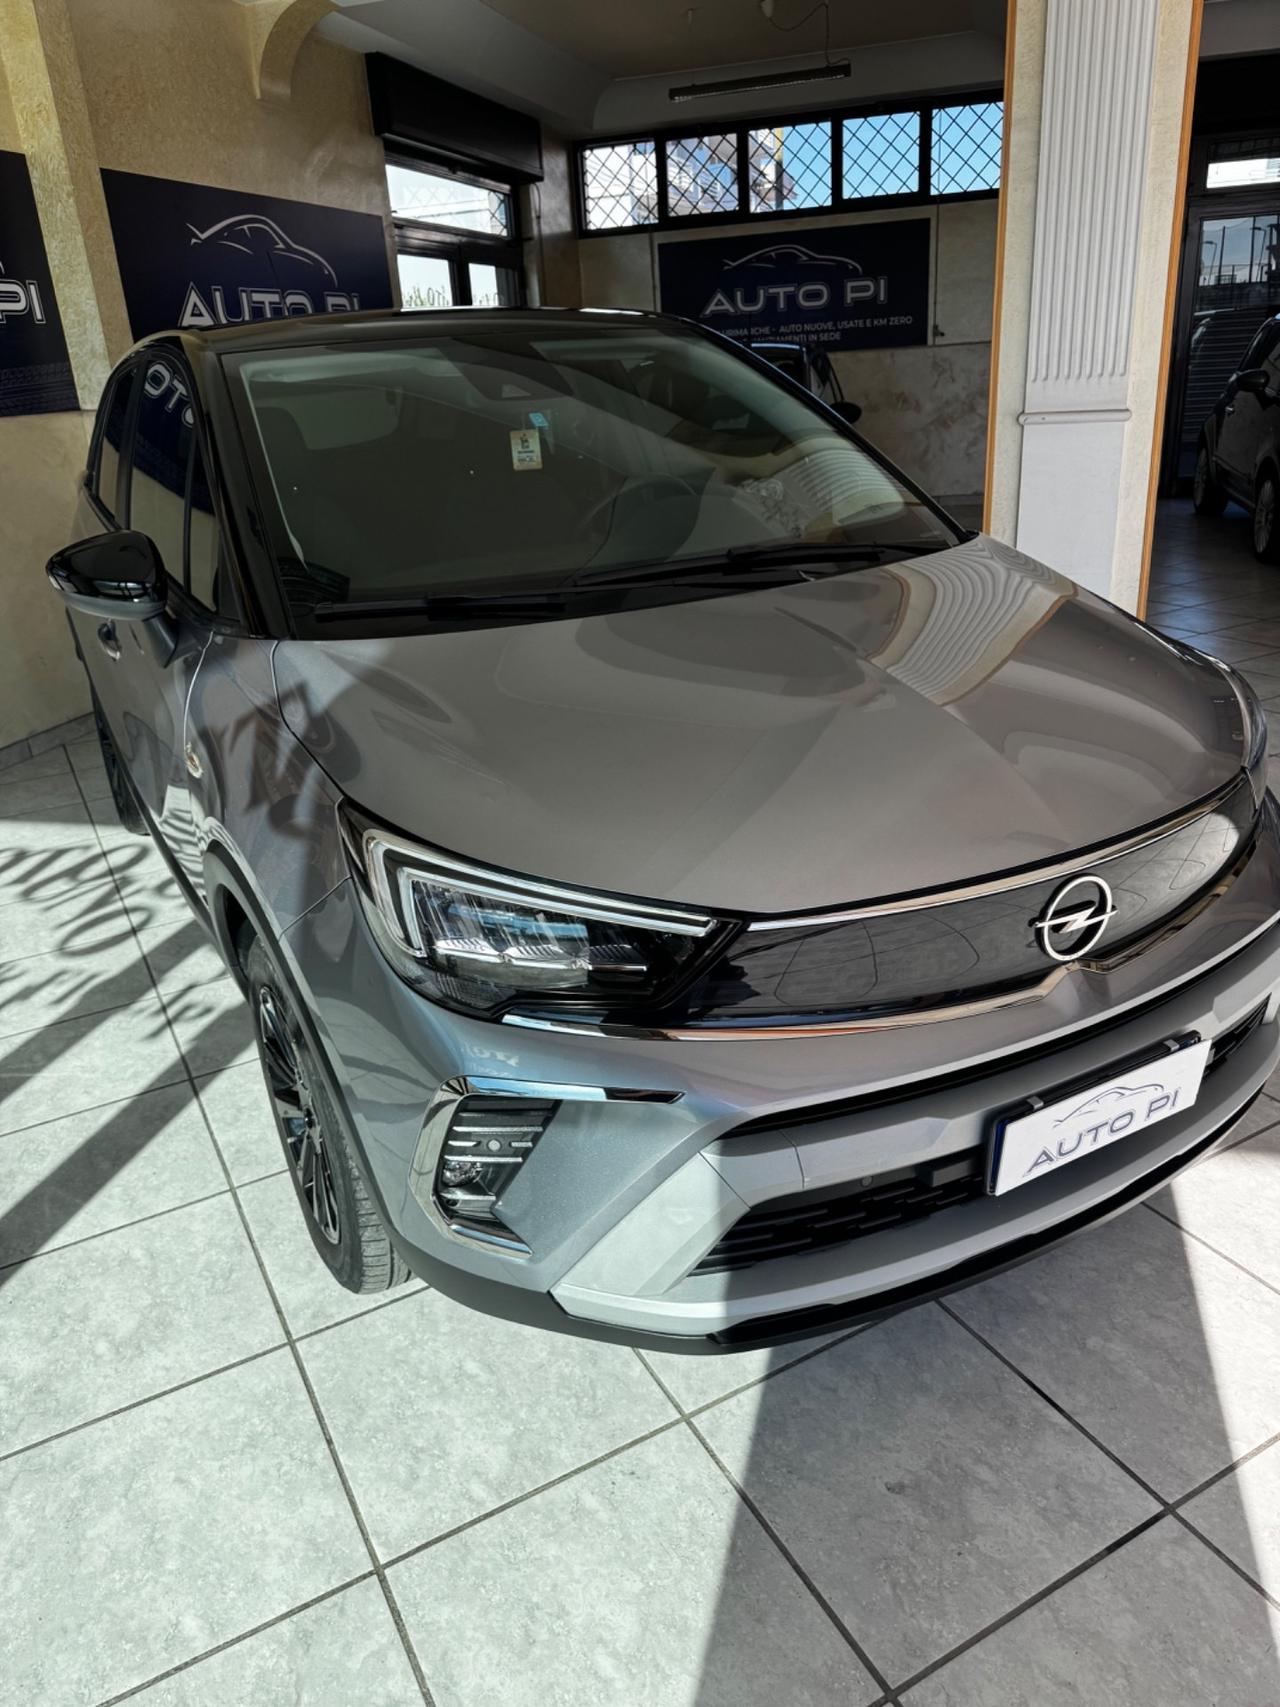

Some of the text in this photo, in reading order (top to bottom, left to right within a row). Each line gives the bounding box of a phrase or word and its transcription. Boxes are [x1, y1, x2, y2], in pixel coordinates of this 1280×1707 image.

[700, 276, 888, 318] AUTO PI
[779, 323, 802, 334] AUTO
[837, 319, 864, 329] USATE
[866, 318, 872, 327] E
[873, 317, 887, 327] KM
[888, 315, 913, 326] ZERO
[1022, 1086, 1181, 1178] AUTO PI
